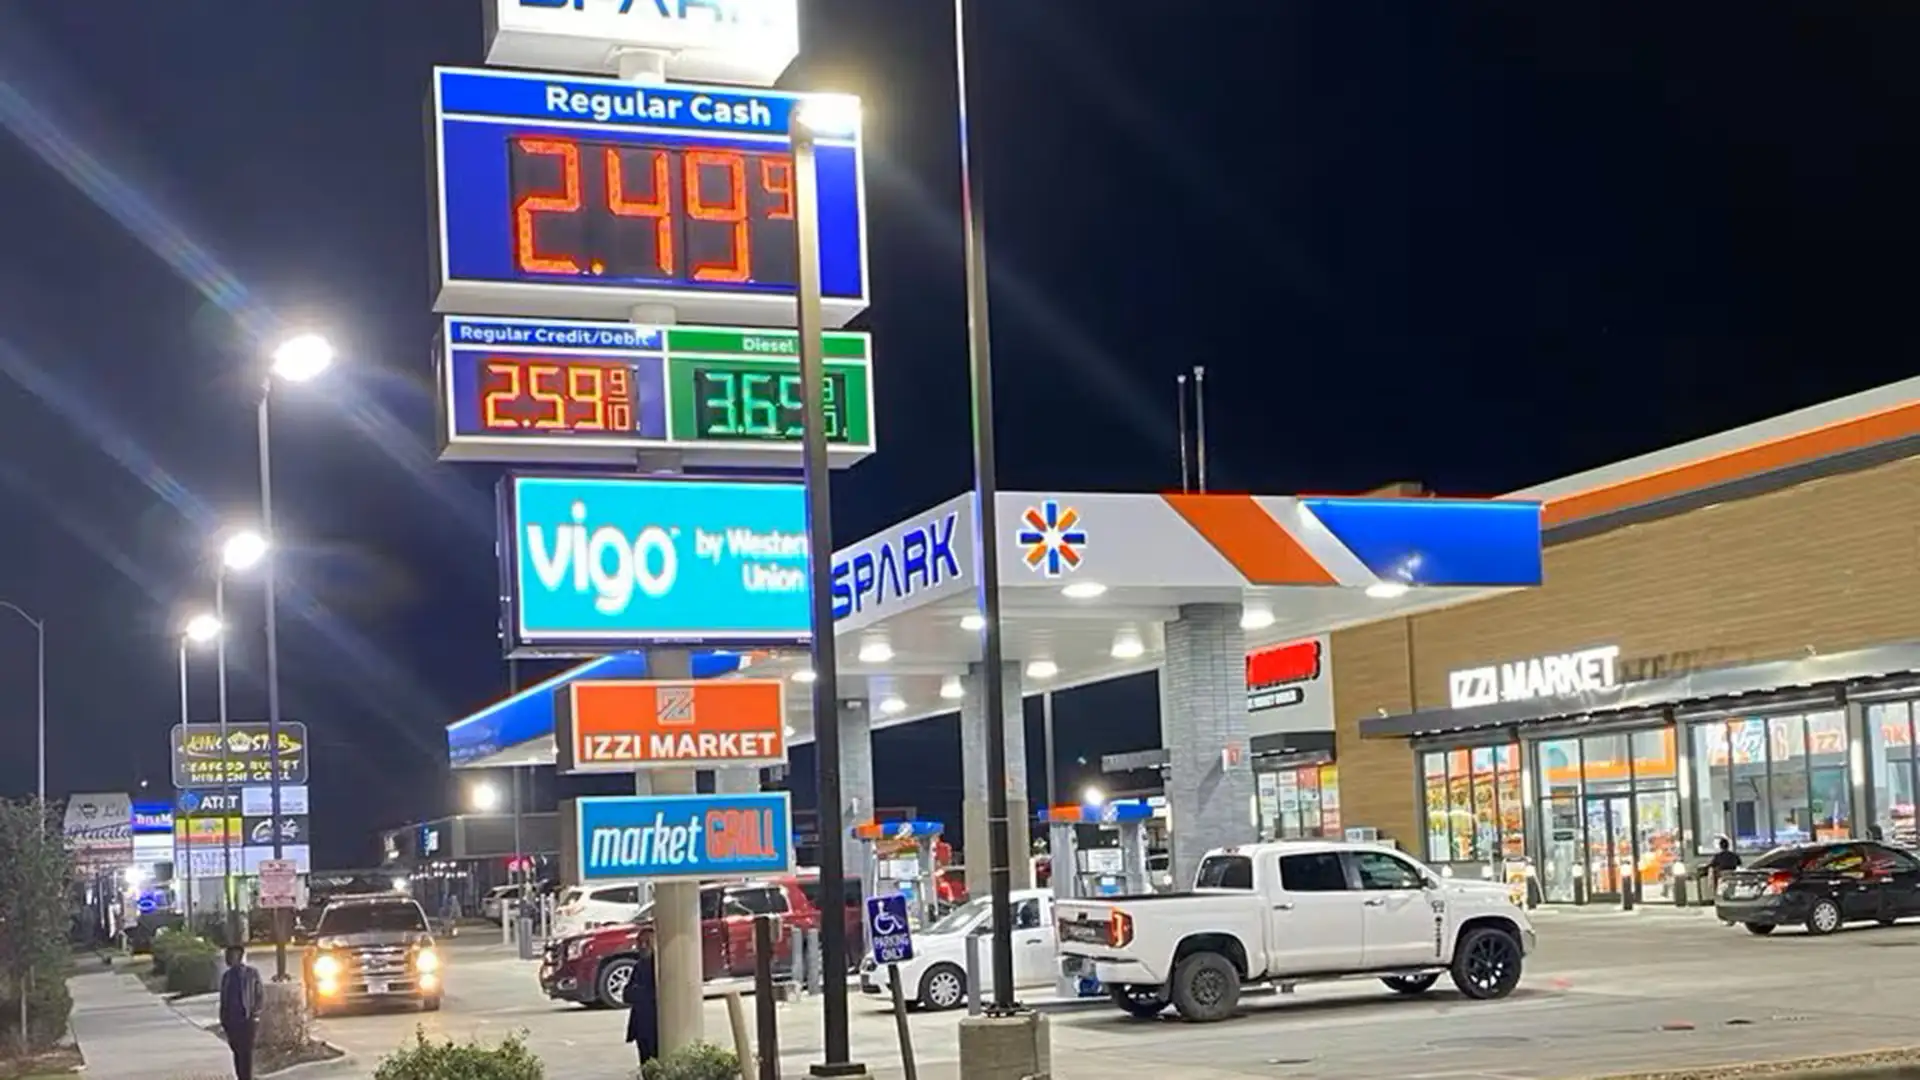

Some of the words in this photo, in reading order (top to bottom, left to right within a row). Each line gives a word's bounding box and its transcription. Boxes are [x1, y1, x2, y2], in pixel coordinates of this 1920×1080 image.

[546, 85, 682, 121] Regular
[690, 95, 771, 127] Cash
[515, 136, 752, 283] 2.49
[460, 326, 529, 343] Regular
[535, 328, 650, 346] Credit/Debit
[743, 337, 795, 353] Diesel
[485, 363, 605, 431] 2.59
[527, 500, 679, 615] vigo
[695, 527, 725, 566] by
[831, 511, 961, 621] SPARK
[742, 561, 805, 592] Union
[1500, 645, 1620, 702] MARKET
[583, 733, 642, 760] IZZI
[649, 731, 778, 758] MARKET
[589, 811, 702, 868] market
[705, 809, 778, 863] GRILL
